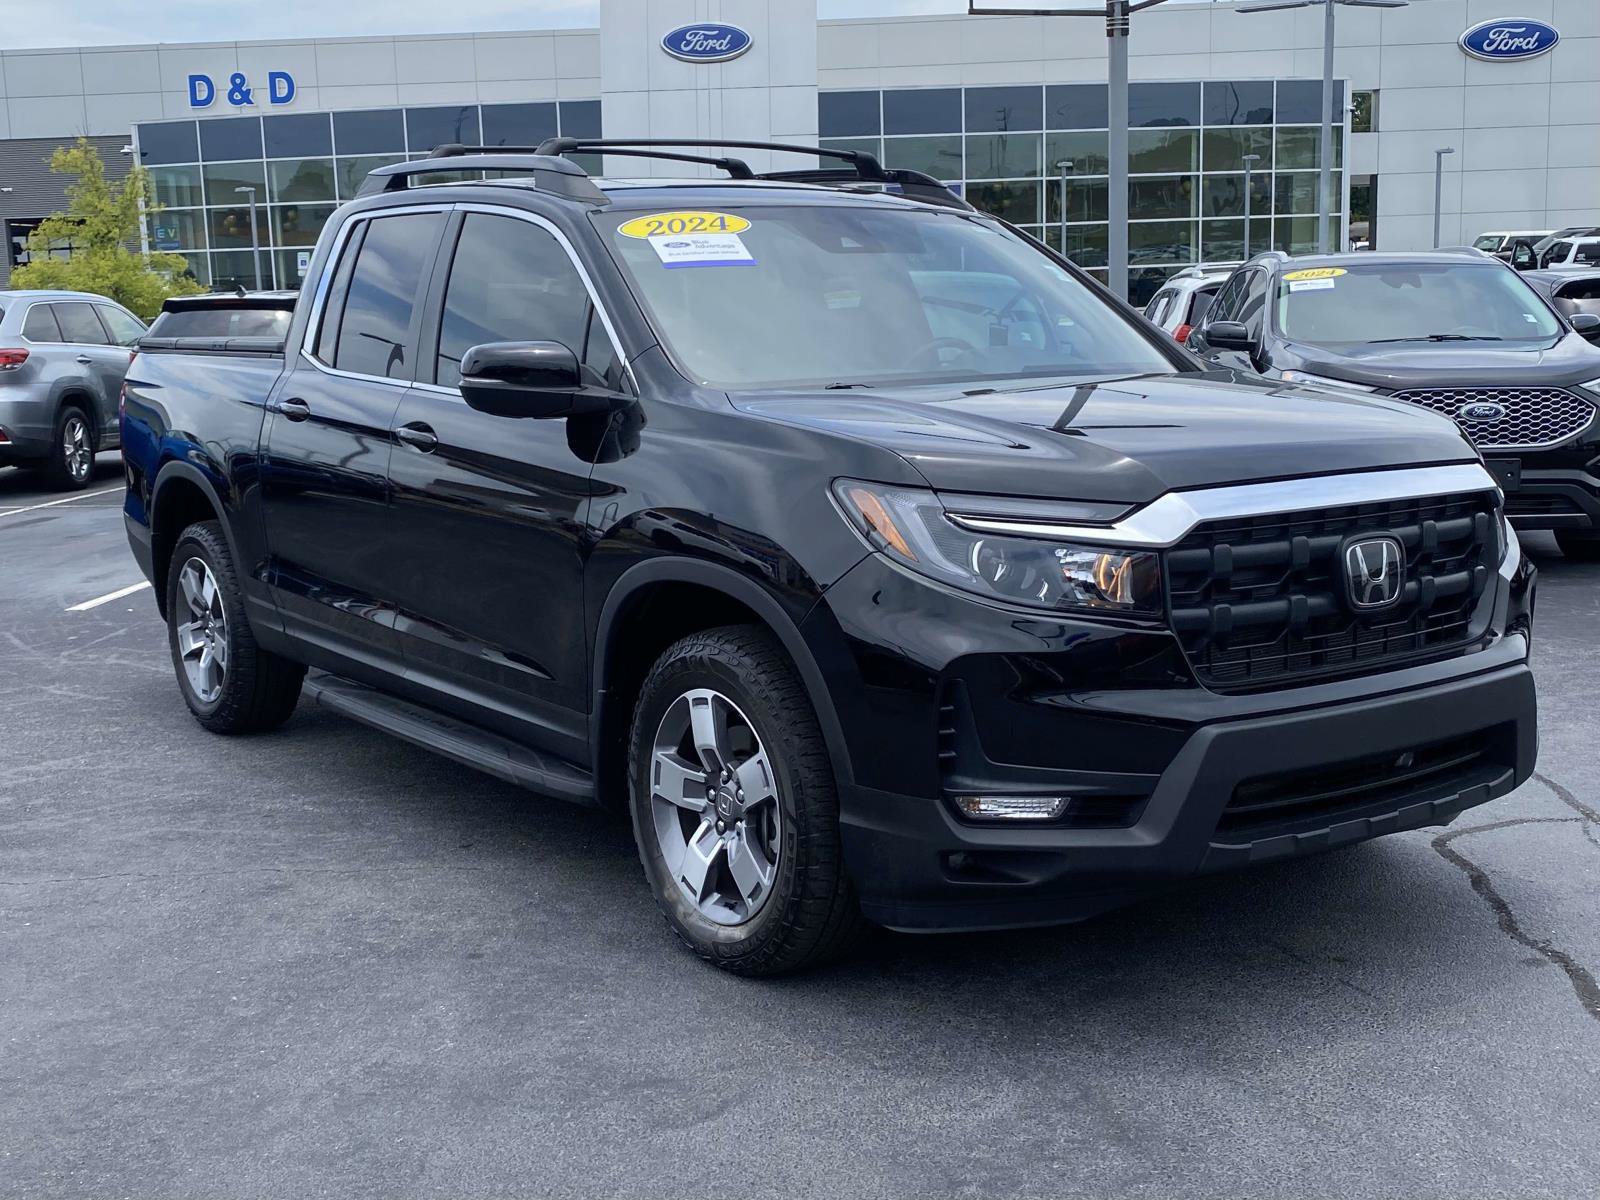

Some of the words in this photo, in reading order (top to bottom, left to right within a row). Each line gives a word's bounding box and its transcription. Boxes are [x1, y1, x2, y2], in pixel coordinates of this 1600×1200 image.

[680, 30, 732, 52] Ford
[1482, 27, 1541, 52] Ford
[188, 74, 216, 107] D
[227, 72, 255, 106] &
[268, 71, 295, 105] D
[646, 215, 730, 237] 2024
[1472, 405, 1496, 417] Ford
